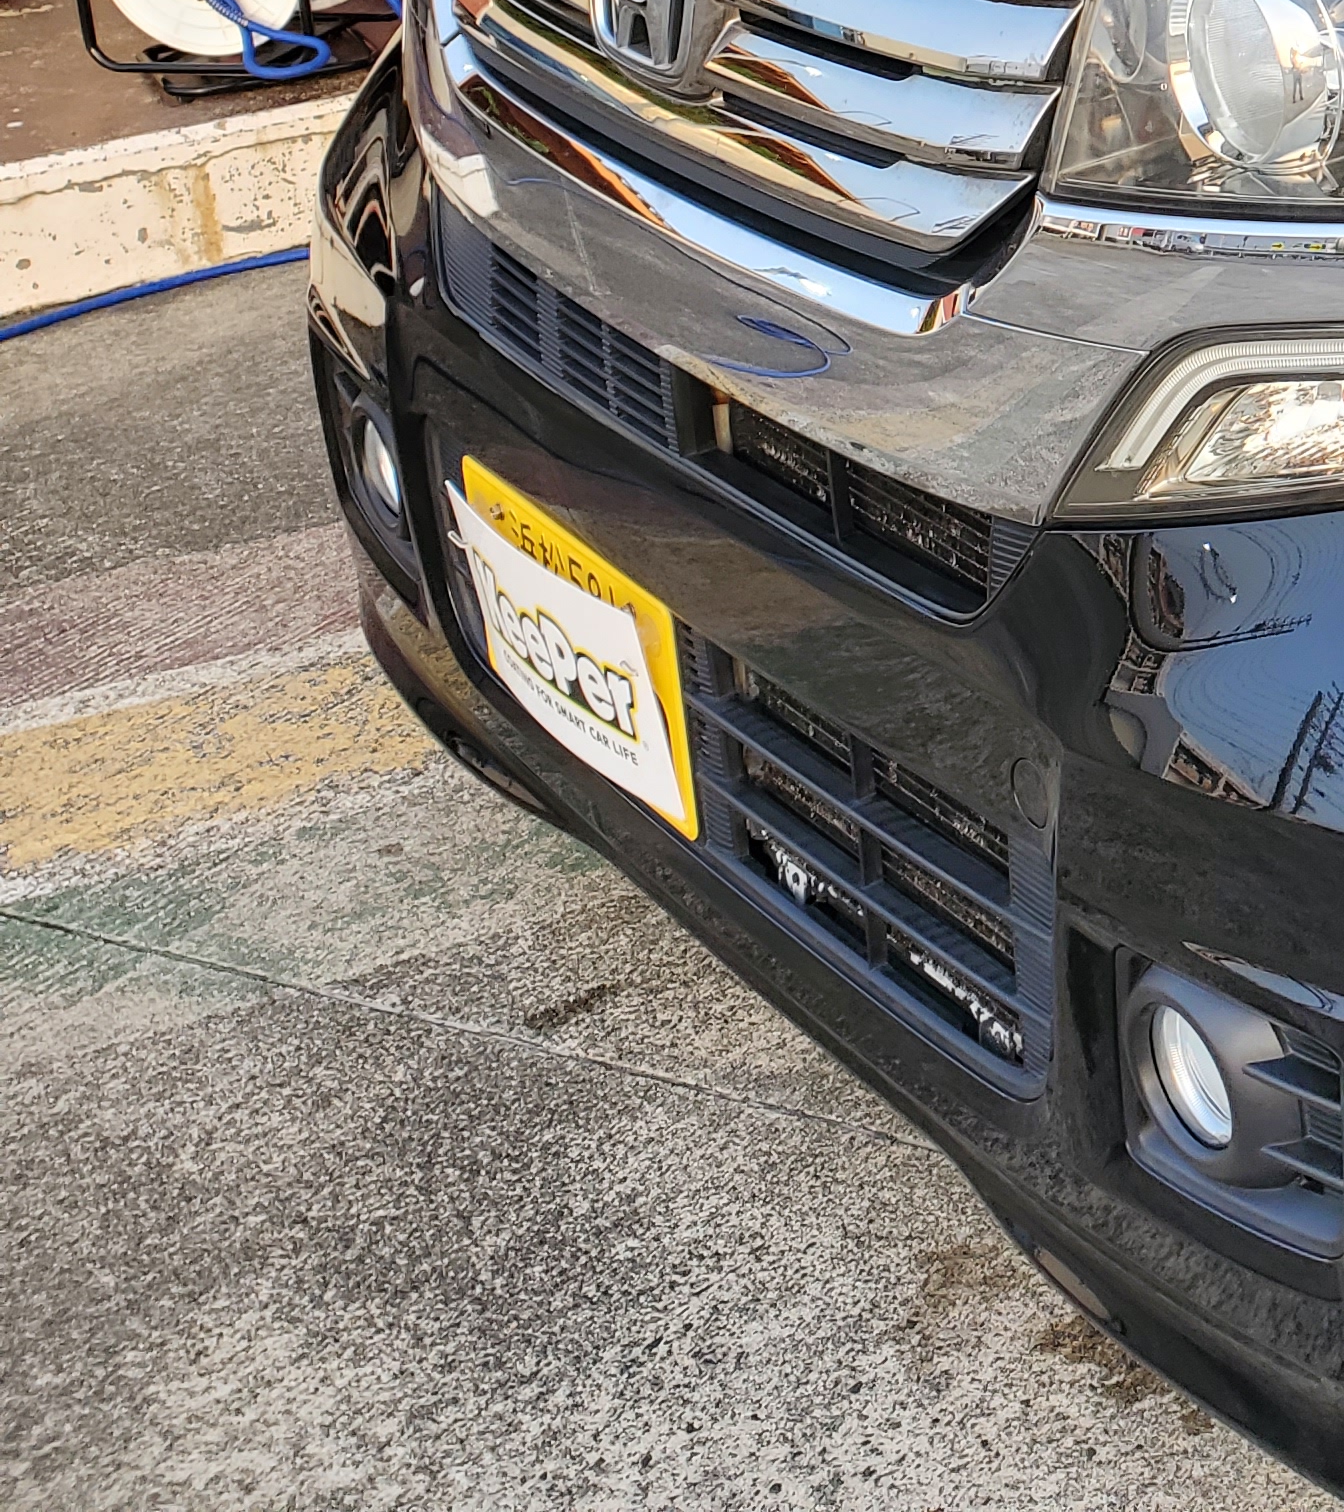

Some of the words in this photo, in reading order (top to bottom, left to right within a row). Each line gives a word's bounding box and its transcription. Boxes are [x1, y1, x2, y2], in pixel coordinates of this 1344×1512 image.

[535, 682, 555, 709] FOR
[554, 697, 588, 735] SMART
[588, 723, 611, 750] CAR
[612, 739, 640, 766] LIFE
